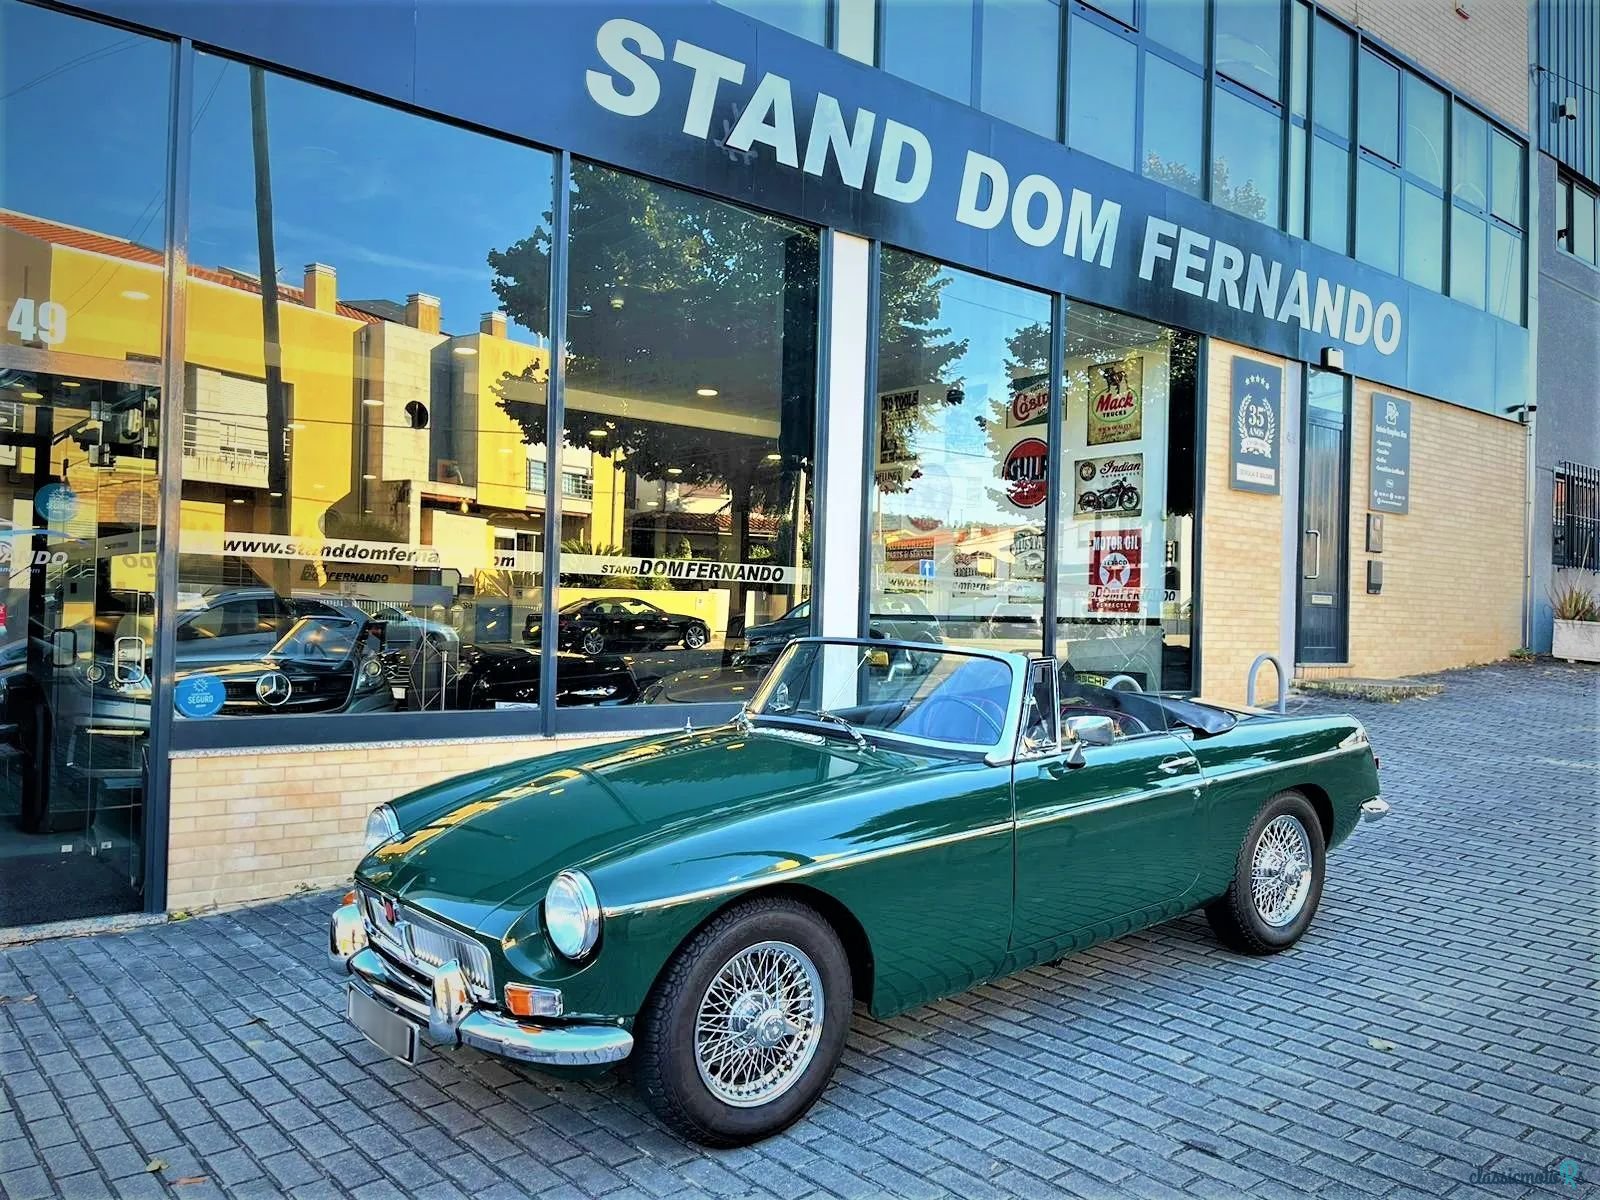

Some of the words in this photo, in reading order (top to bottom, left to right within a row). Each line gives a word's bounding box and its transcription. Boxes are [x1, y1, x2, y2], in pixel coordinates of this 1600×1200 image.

[585, 19, 932, 203] STAND
[956, 150, 1122, 269] DOM
[1139, 215, 1402, 357] FERNANDO
[8, 298, 67, 345] 49
[1096, 392, 1134, 413] Mack
[1248, 404, 1266, 427] 35
[1100, 460, 1141, 474] Indian
[1093, 536, 1122, 551] MOTOR
[1125, 536, 1139, 550] OIL
[601, 564, 638, 575] STAND
[686, 562, 784, 583] FERNANDO
[187, 695, 214, 704] SEGURO
